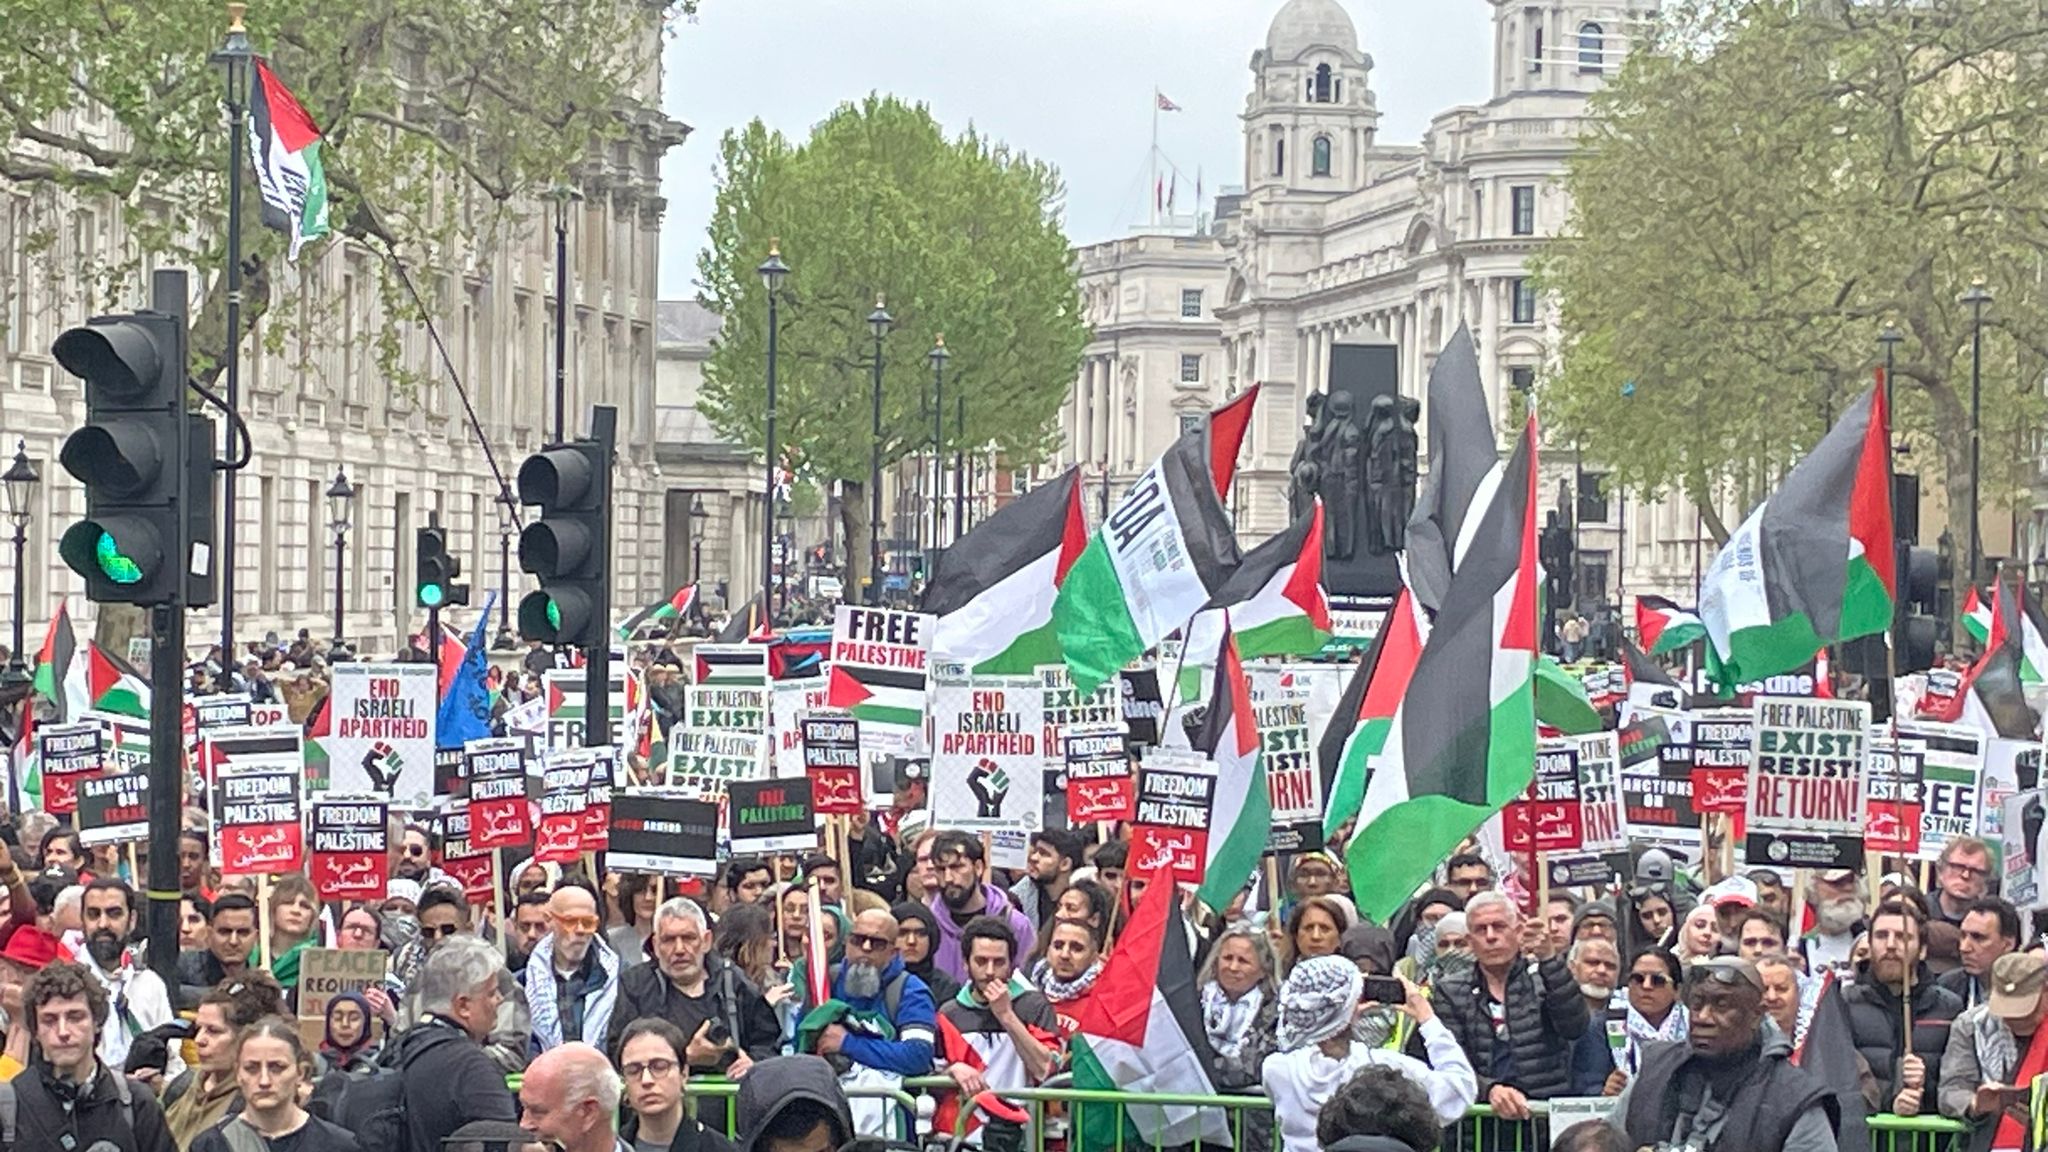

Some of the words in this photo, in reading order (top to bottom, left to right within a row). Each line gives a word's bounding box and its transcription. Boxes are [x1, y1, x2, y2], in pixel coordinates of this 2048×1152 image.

[849, 609, 921, 646] FREE
[835, 641, 927, 670] PALESTINE
[369, 678, 401, 699] END
[354, 698, 414, 719] ISRAELI
[690, 691, 714, 709] FREE
[716, 691, 764, 709] PALESTINE
[973, 691, 1005, 713] END
[199, 705, 247, 722] FREEDOM
[691, 710, 764, 728] EXIST!
[958, 712, 1020, 734] ISRAELI
[1043, 708, 1116, 725] RESIST!
[1759, 703, 1794, 727] FREE
[1796, 705, 1864, 731] PALESTINE
[339, 718, 428, 739] APARTHEID
[548, 720, 625, 748] FRE
[1260, 728, 1309, 751] IST!
[46, 733, 96, 752] FREEDOM
[675, 732, 701, 753] FREE
[703, 734, 758, 758] PALESTINE
[943, 733, 1035, 755] APARTHEID
[1068, 736, 1124, 756] FREEDOM
[1580, 737, 1612, 761] STINE
[1759, 730, 1863, 758] EXIST!
[45, 753, 102, 773] PALESTINE
[473, 752, 520, 774] FREEDOM
[674, 754, 756, 779] EXIST!
[1068, 760, 1130, 779] PALESTINE
[1267, 752, 1311, 772] IST!
[1580, 761, 1614, 785] ST!
[1758, 756, 1862, 779] RESIST!
[84, 774, 149, 798] SANCTIO
[225, 776, 292, 798] FREEDOM
[471, 777, 525, 801] PALESTINE
[1144, 772, 1209, 798] FREEDOM
[1622, 777, 1694, 797] ANCTIONS
[117, 792, 139, 808] ON
[1643, 794, 1664, 808] ON
[1755, 775, 1860, 823] RETURN!
[223, 802, 297, 825] PALESTINE
[318, 805, 382, 825] FREEDOM
[739, 804, 806, 825] PALESTINE
[1137, 801, 1209, 828] PALESTINE
[1922, 816, 1971, 835] STINE
[315, 832, 386, 851] PALESTINE
[306, 950, 383, 974] PEACE
